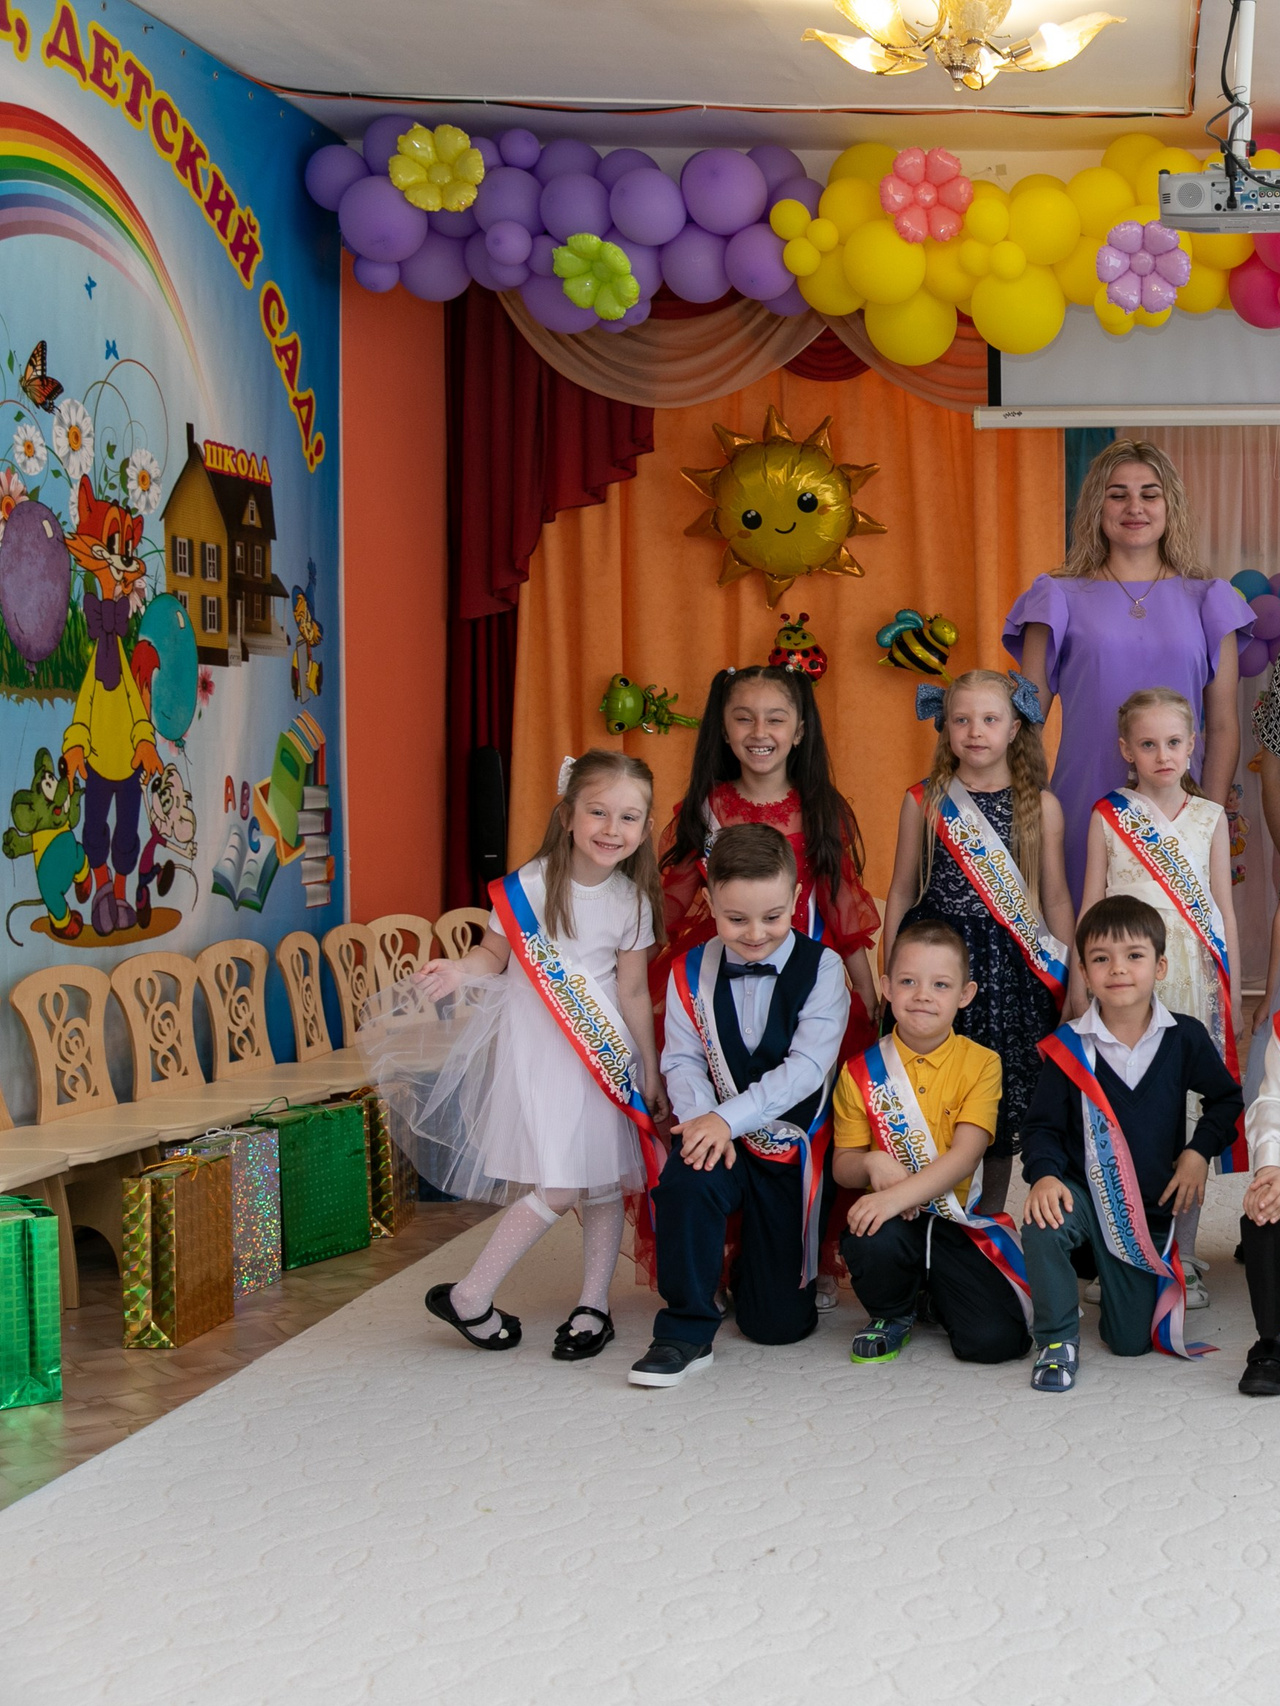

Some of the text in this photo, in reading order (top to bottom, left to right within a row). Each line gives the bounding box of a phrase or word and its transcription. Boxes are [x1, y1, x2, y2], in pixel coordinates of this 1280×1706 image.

[44, 2, 324, 470] ДЕТСКИЙ САД!
[204, 442, 272, 485] ШКОЛА
[972, 851, 1040, 954] детского сада
[990, 850, 1039, 935] Выпускник
[1145, 838, 1212, 941] детского сада
[1163, 836, 1212, 922] Выпускник
[550, 974, 629, 1086] детского сада
[568, 973, 632, 1066] Выпускник
